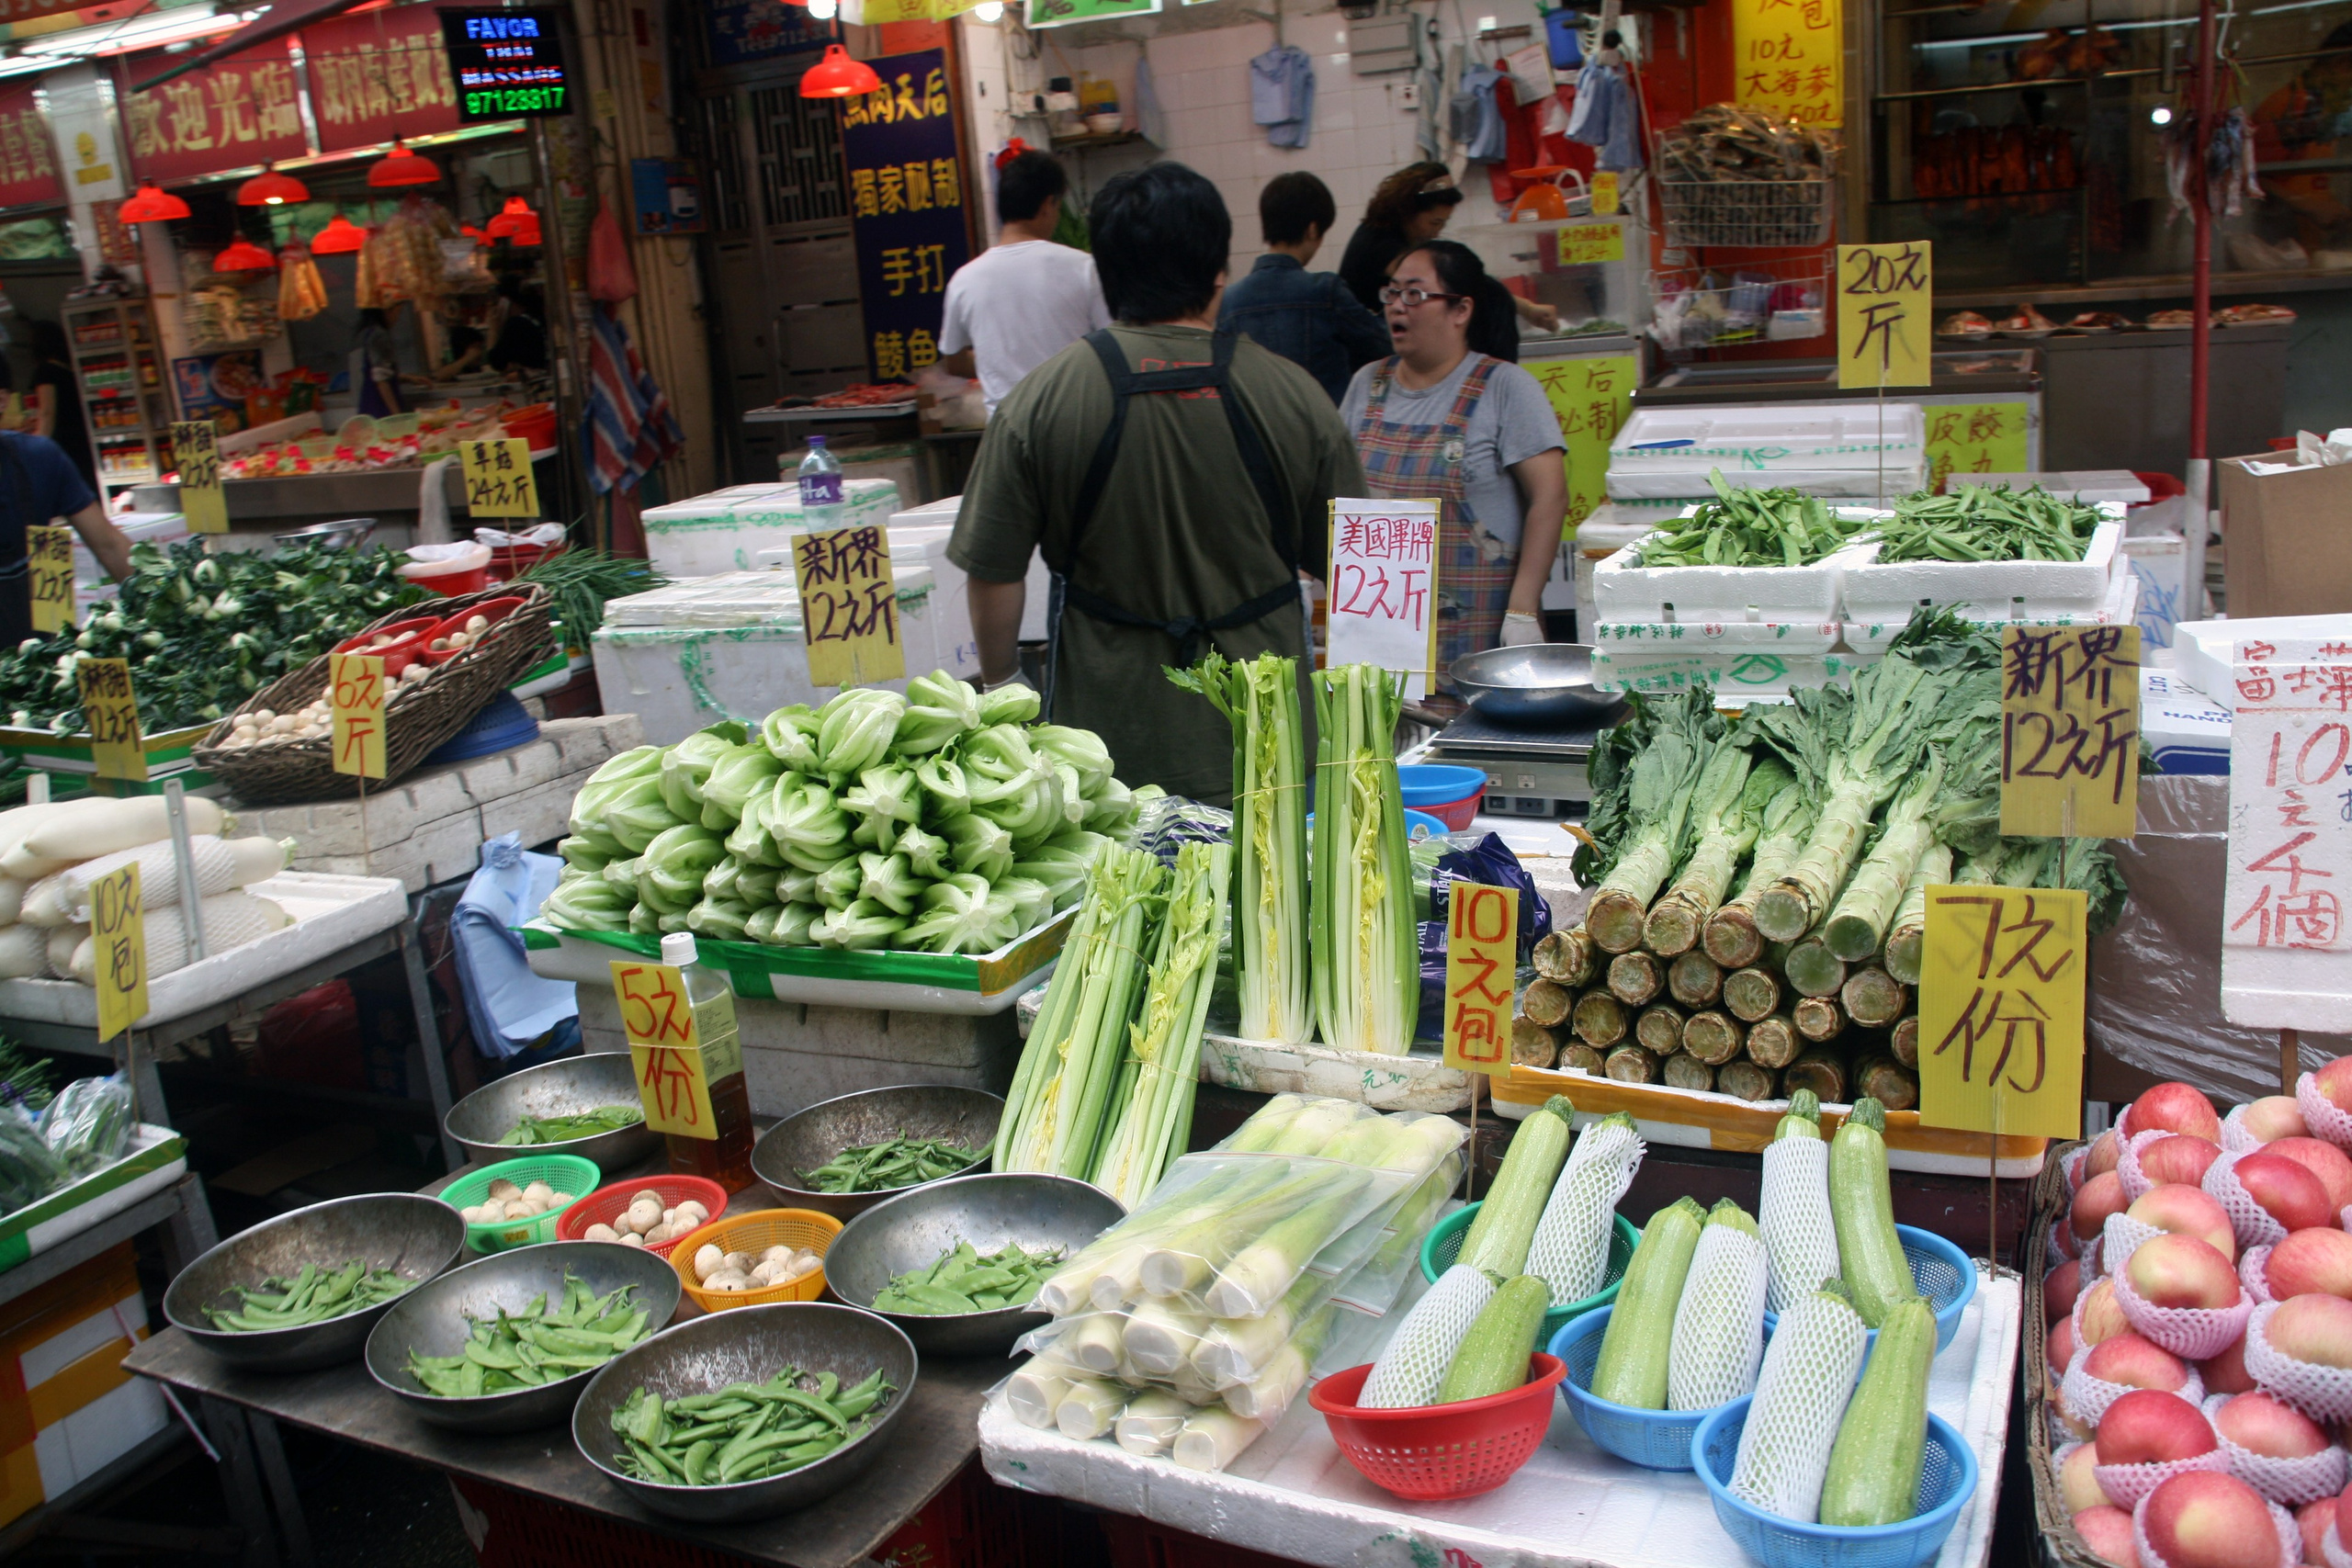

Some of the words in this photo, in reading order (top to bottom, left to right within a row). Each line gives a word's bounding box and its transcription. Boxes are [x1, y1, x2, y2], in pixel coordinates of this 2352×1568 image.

[465, 17, 540, 39] FAVOR
[881, 244, 945, 297] 手打
[797, 525, 888, 592] 新界
[2004, 626, 2139, 711] 新界
